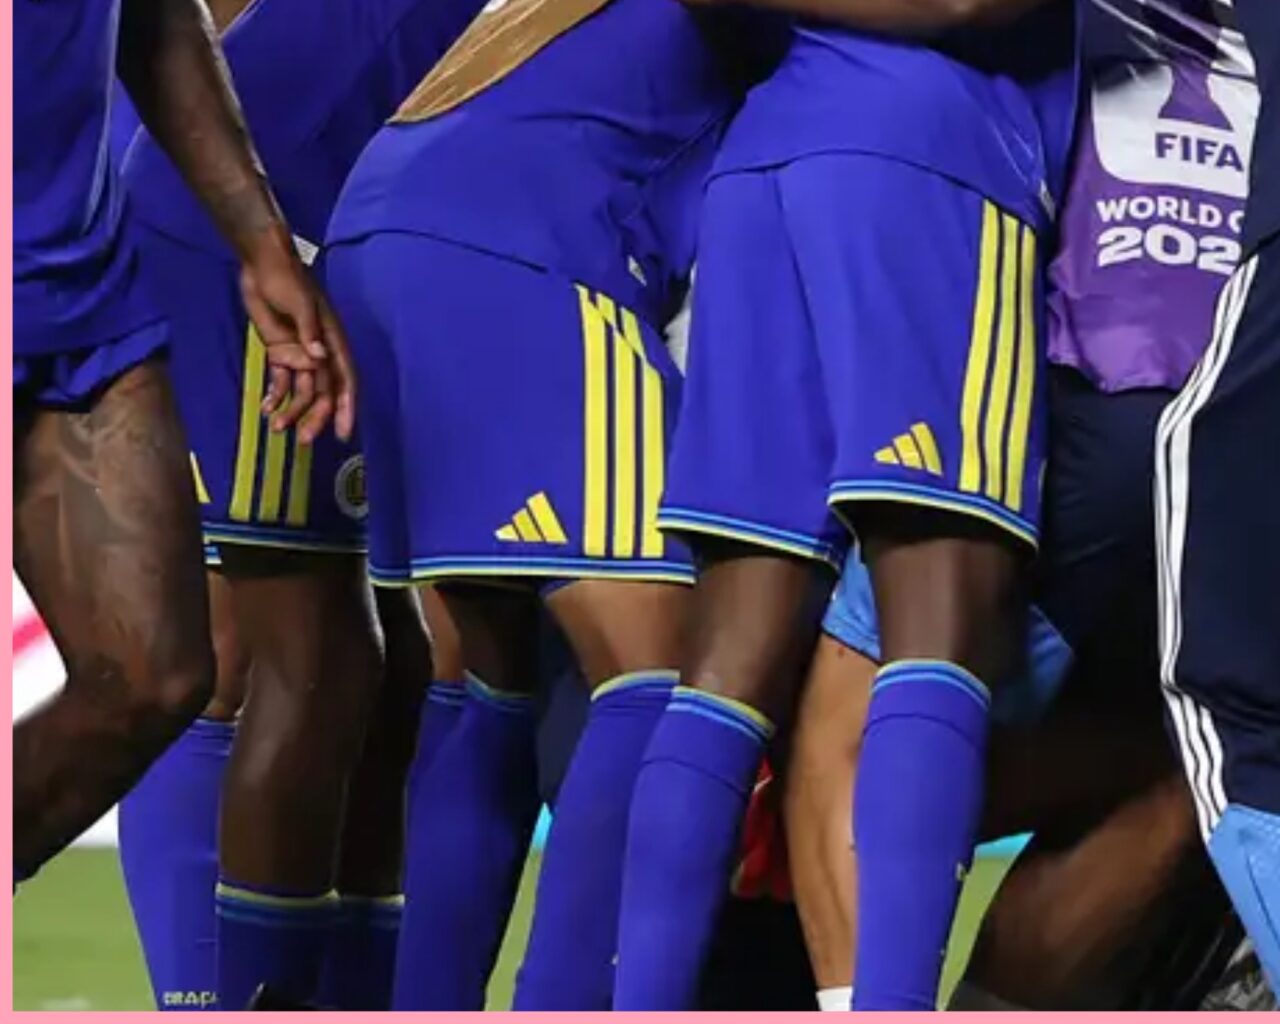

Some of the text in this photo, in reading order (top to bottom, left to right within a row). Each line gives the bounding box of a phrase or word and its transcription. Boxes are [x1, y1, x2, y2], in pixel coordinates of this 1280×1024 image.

[1155, 131, 1244, 172] FIFA
[1096, 195, 1223, 228] WORLD
[1096, 223, 1243, 276] 202
